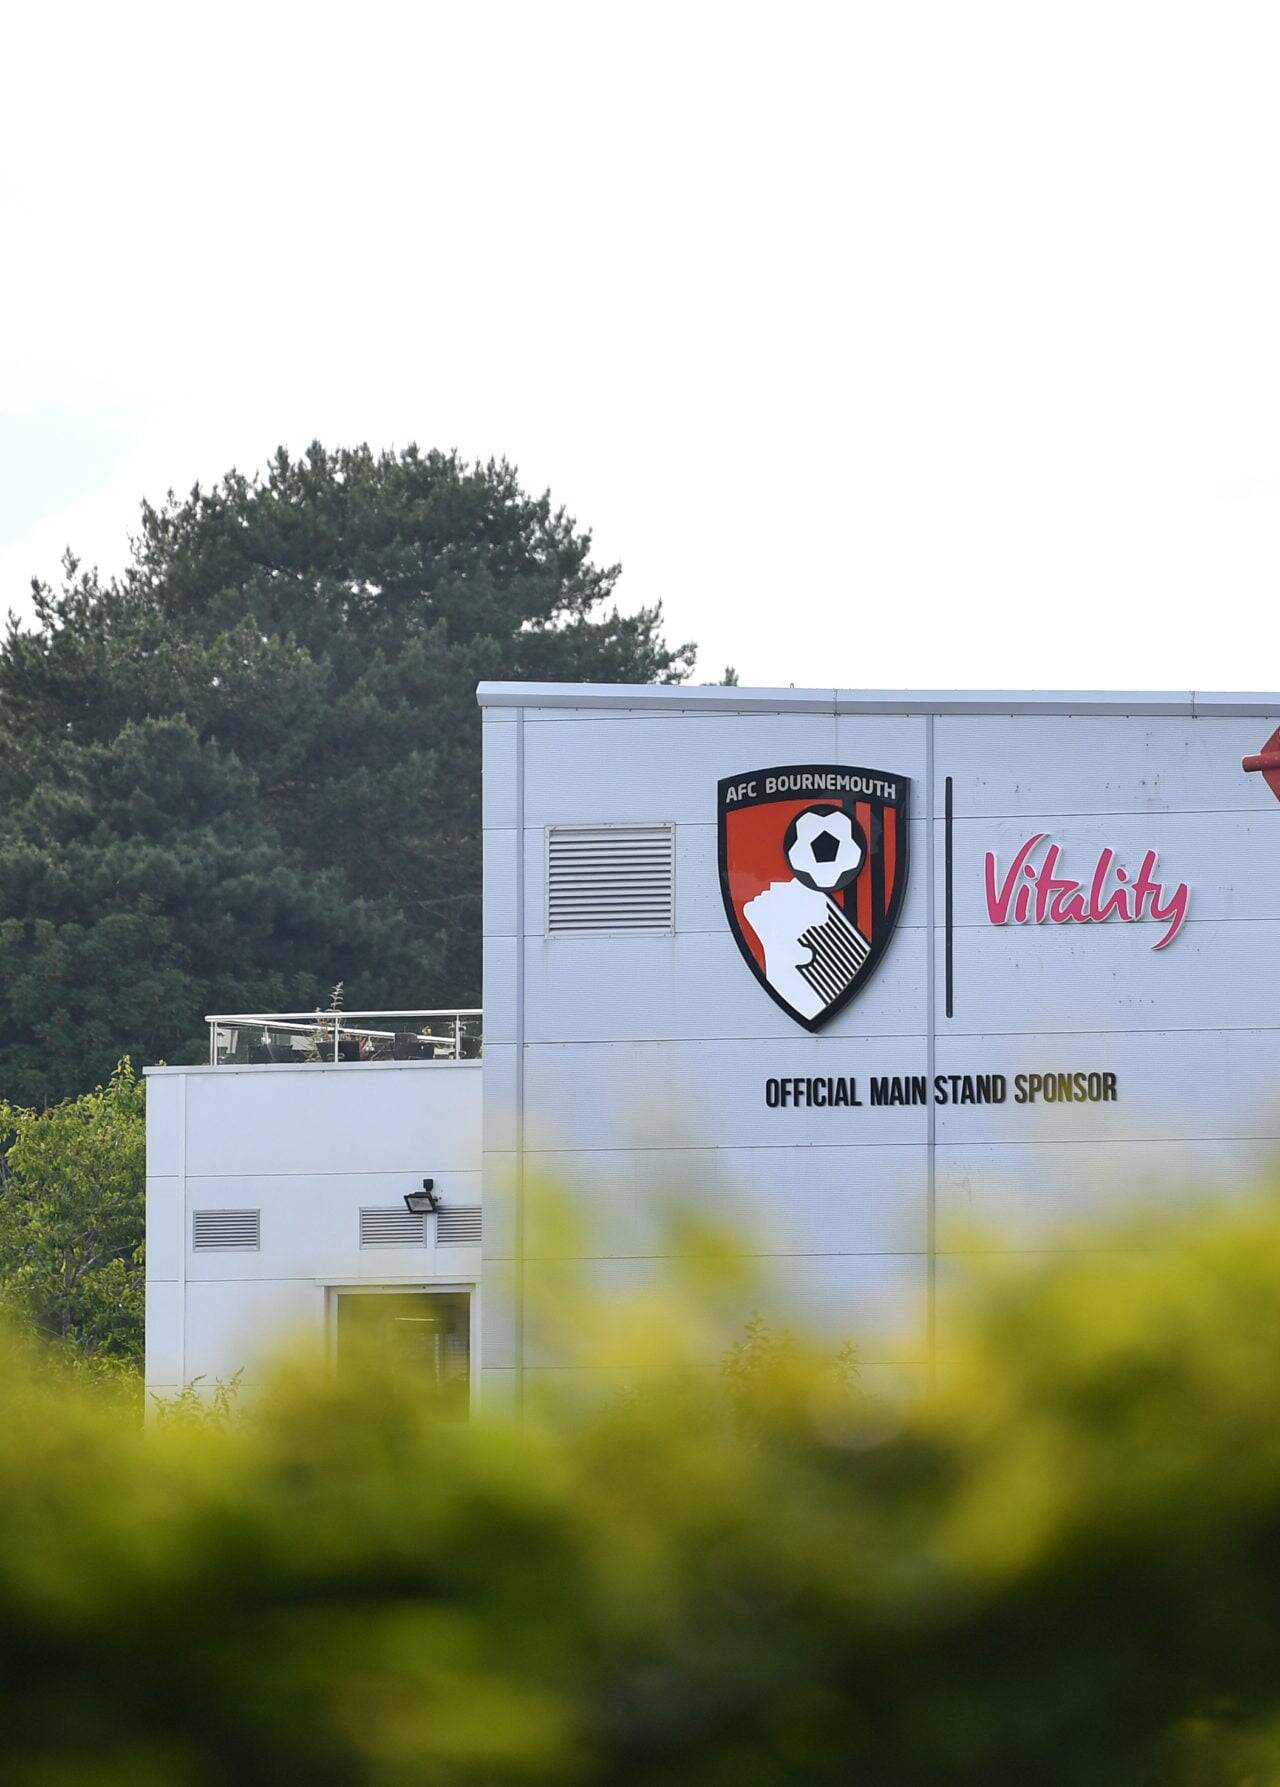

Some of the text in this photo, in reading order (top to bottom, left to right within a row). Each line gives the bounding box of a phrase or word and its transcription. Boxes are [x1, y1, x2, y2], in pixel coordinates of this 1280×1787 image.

[726, 773, 896, 803] AFC BOURNEMOUTH
[984, 833, 1189, 950] Vitality
[765, 1072, 1117, 1108] OFFICIAL MAIN STAND SPONSOR
